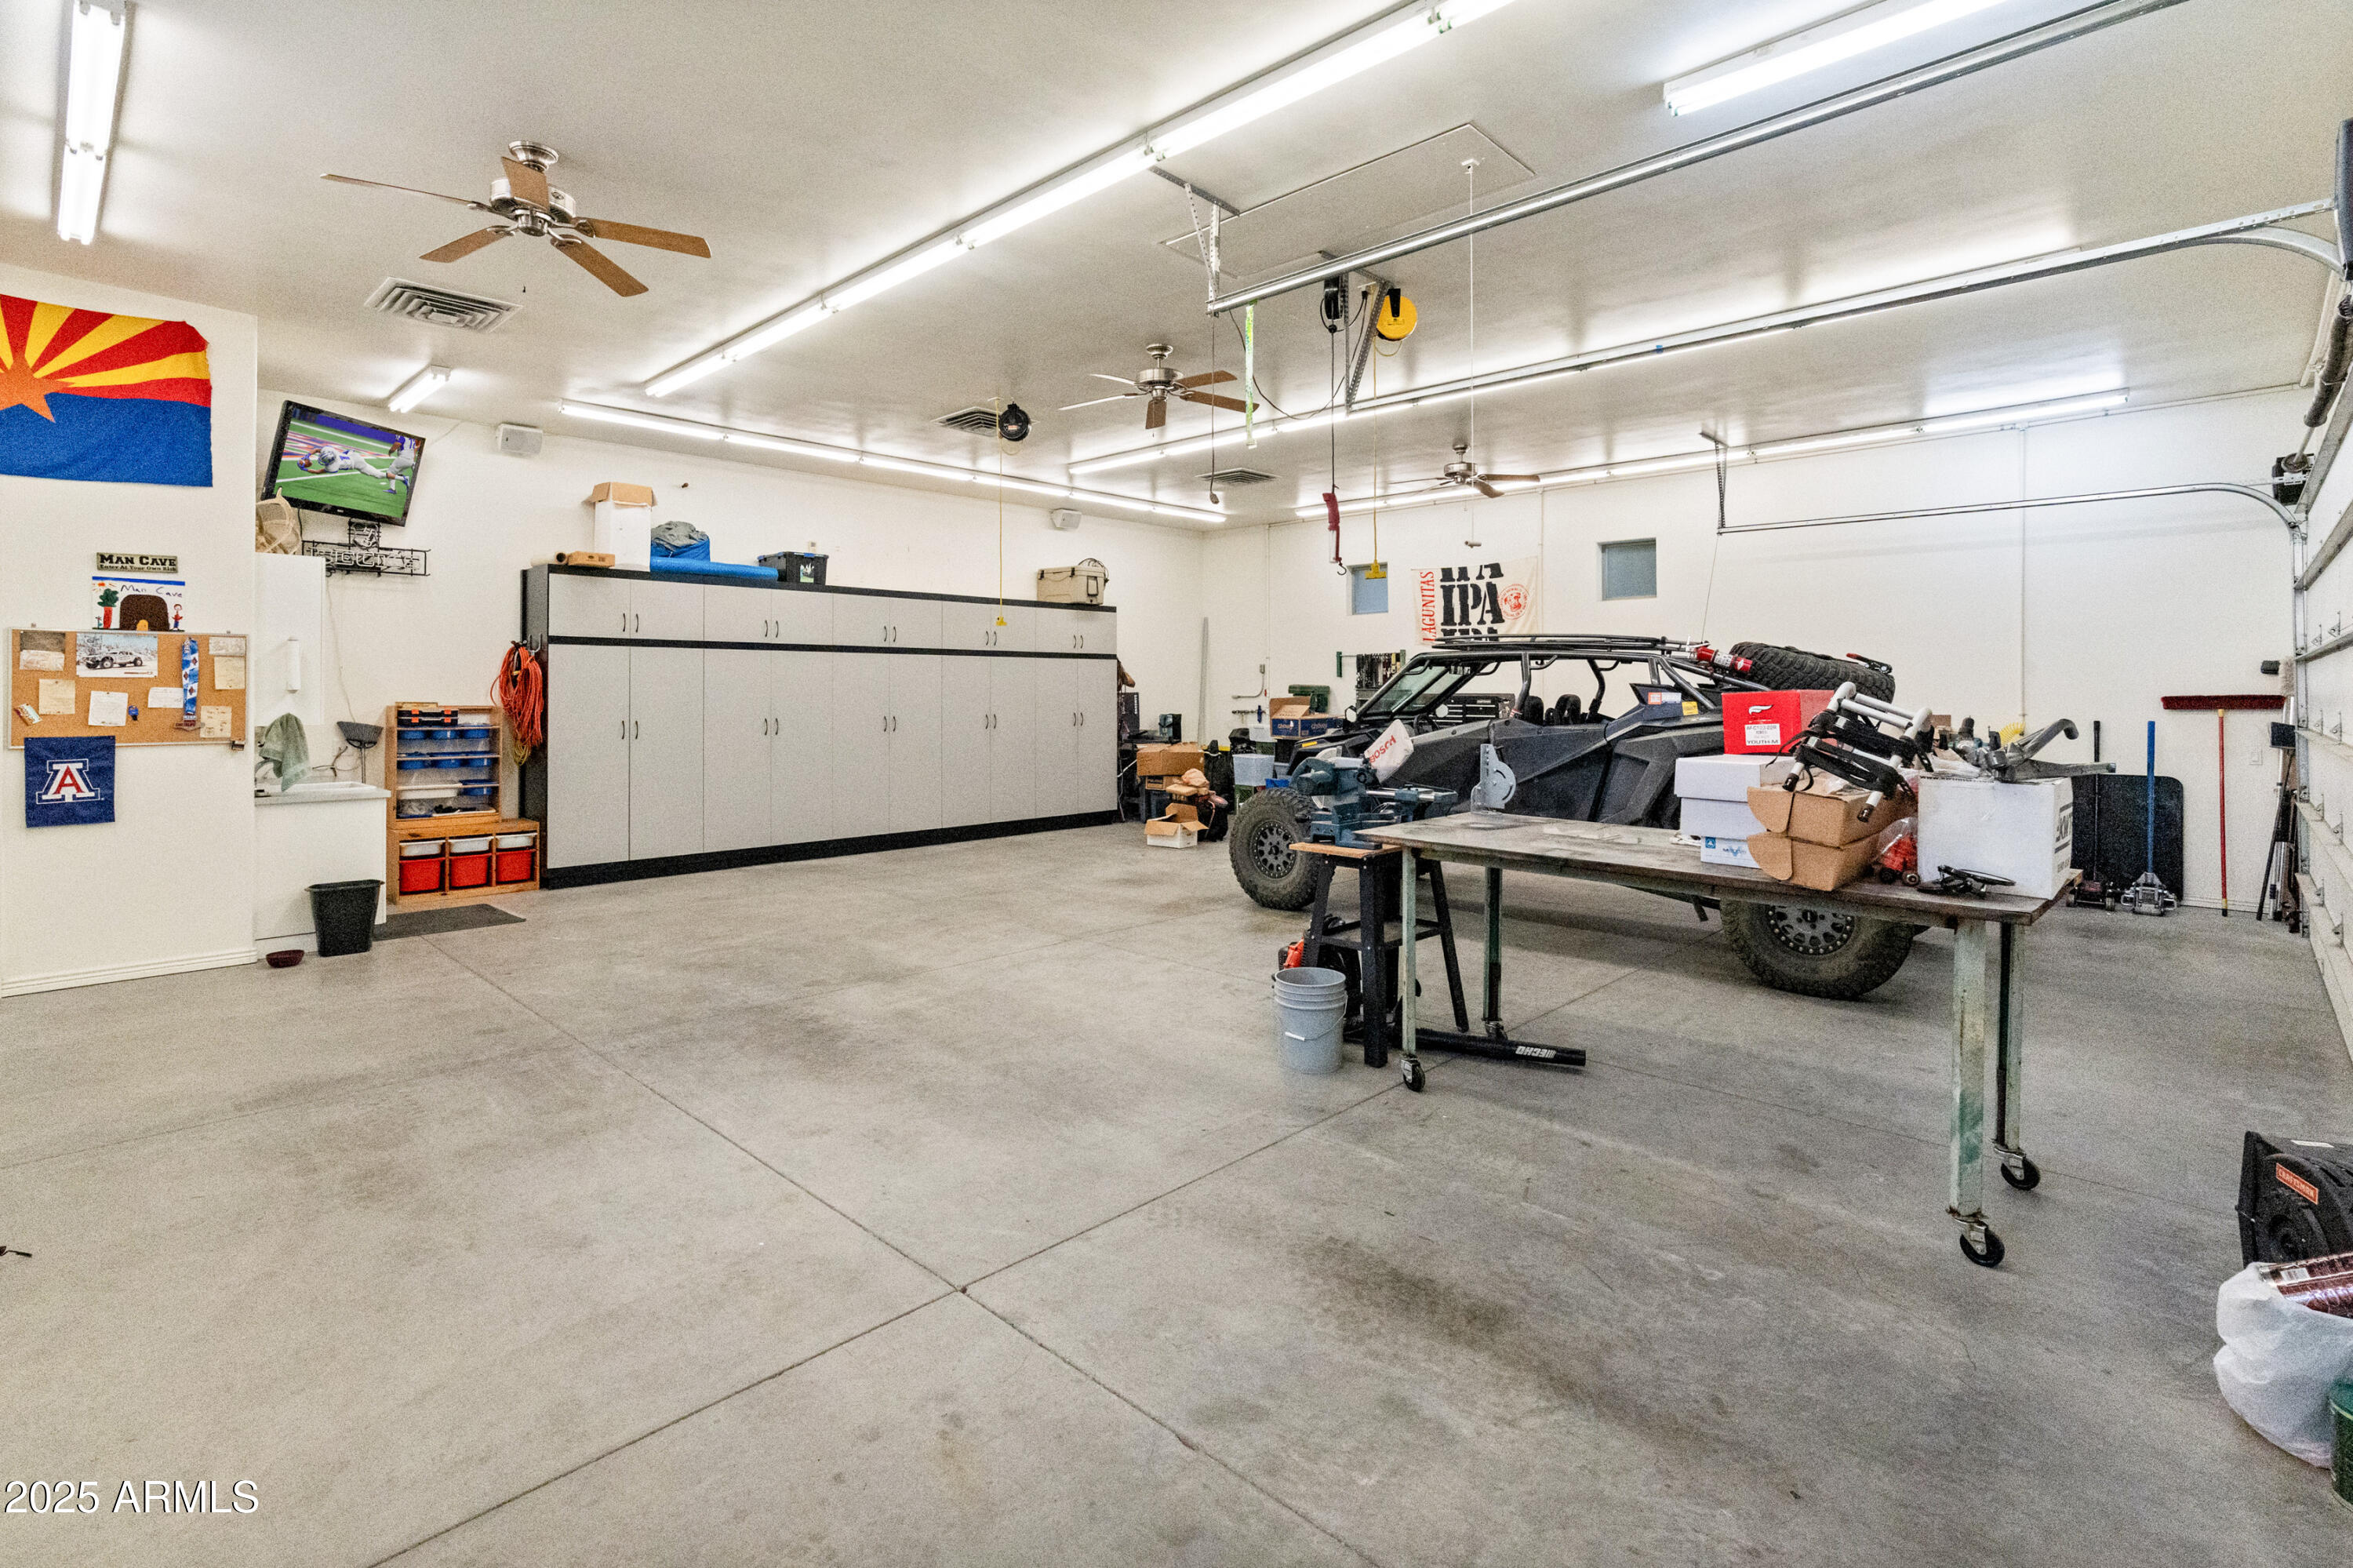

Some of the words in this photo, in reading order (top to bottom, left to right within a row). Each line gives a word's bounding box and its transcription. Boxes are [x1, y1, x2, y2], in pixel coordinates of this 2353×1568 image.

[100, 554, 135, 565] MAN
[139, 555, 176, 566] CAVE
[120, 584, 147, 593] Man
[156, 586, 183, 598] Cave
[1440, 581, 1505, 626] IPA
[1420, 571, 1437, 642] LAGUNITAS
[1369, 734, 1397, 763] BOSCH
[1515, 1046, 1549, 1058] ECHO
[2278, 1168, 2315, 1199] CRAFTSMAN
